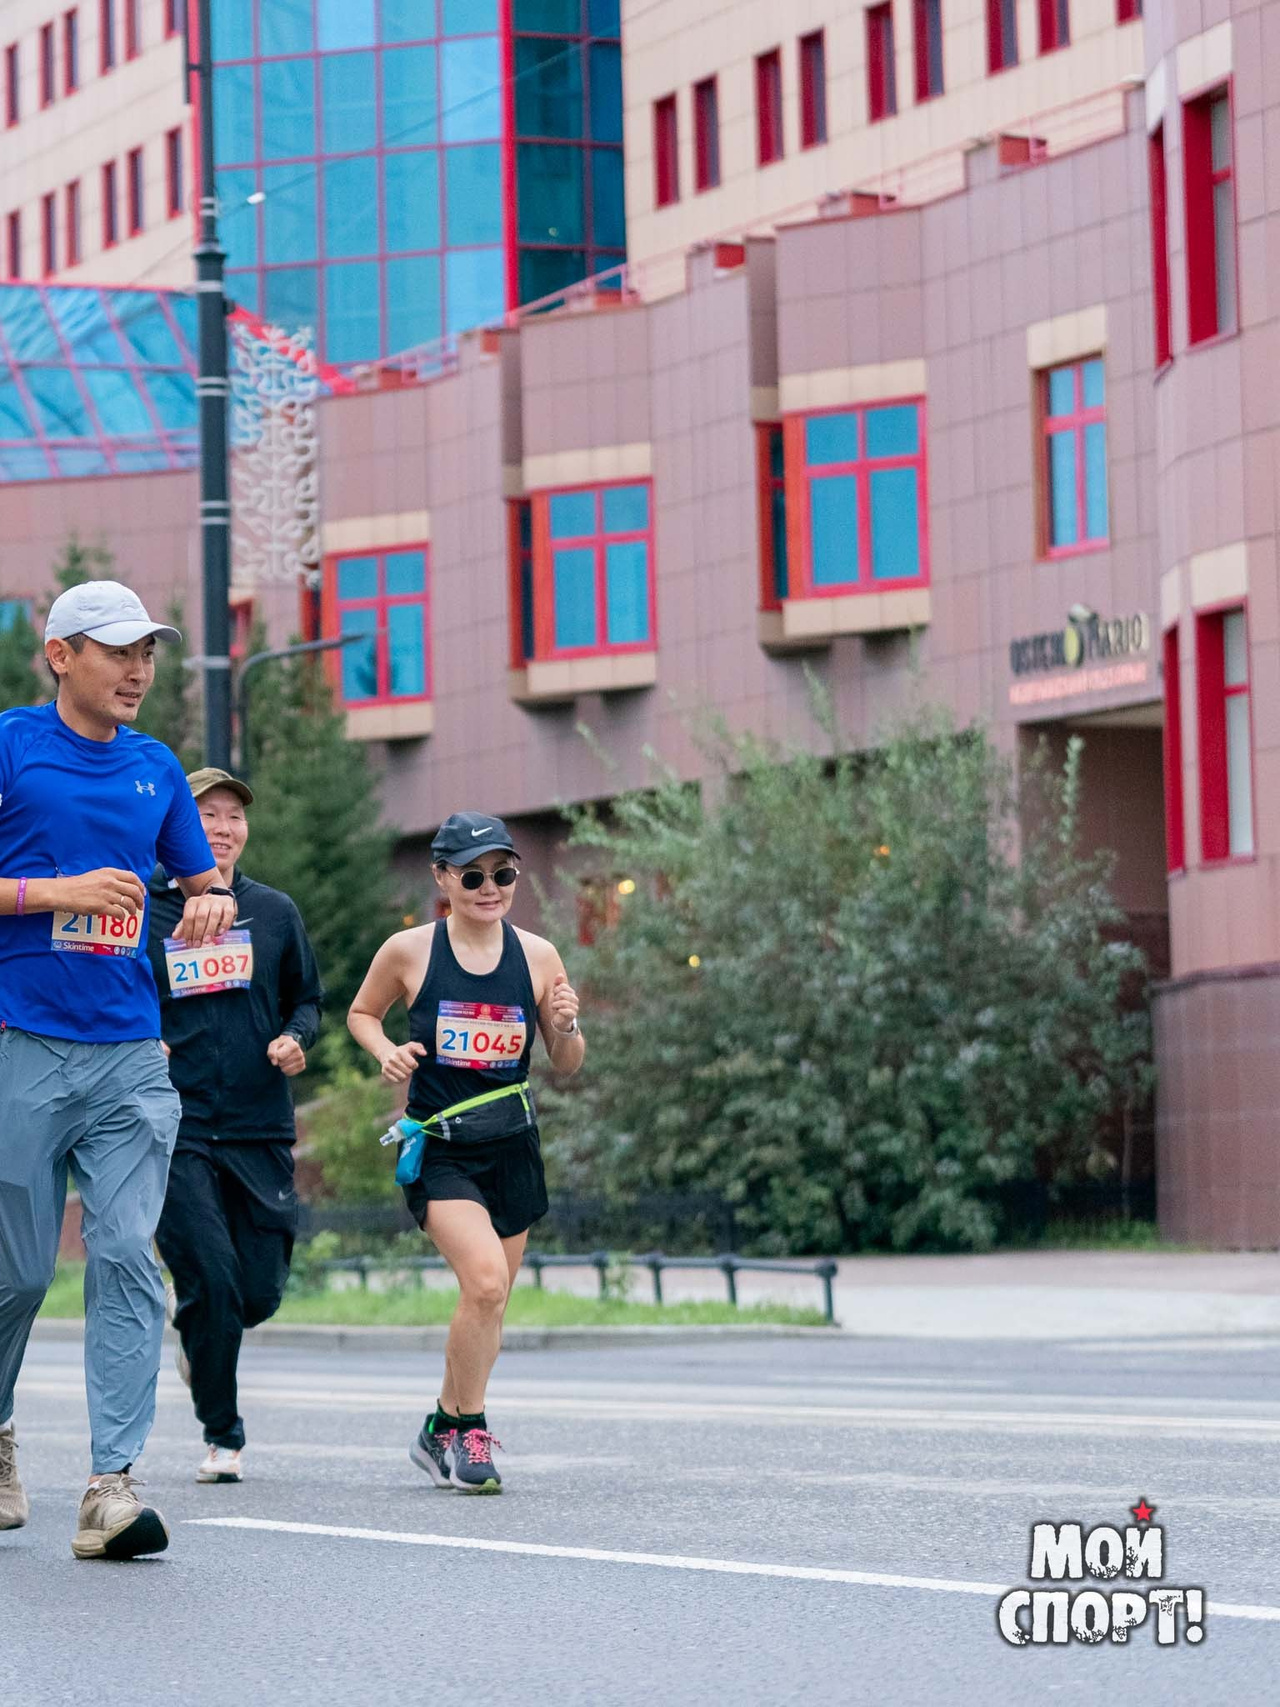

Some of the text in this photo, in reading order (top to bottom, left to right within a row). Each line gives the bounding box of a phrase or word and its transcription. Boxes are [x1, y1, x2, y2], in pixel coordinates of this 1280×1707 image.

[61, 912, 138, 939] 21180
[63, 942, 95, 953] Skintime
[173, 954, 249, 982] 21087
[441, 1028, 522, 1054] 21045
